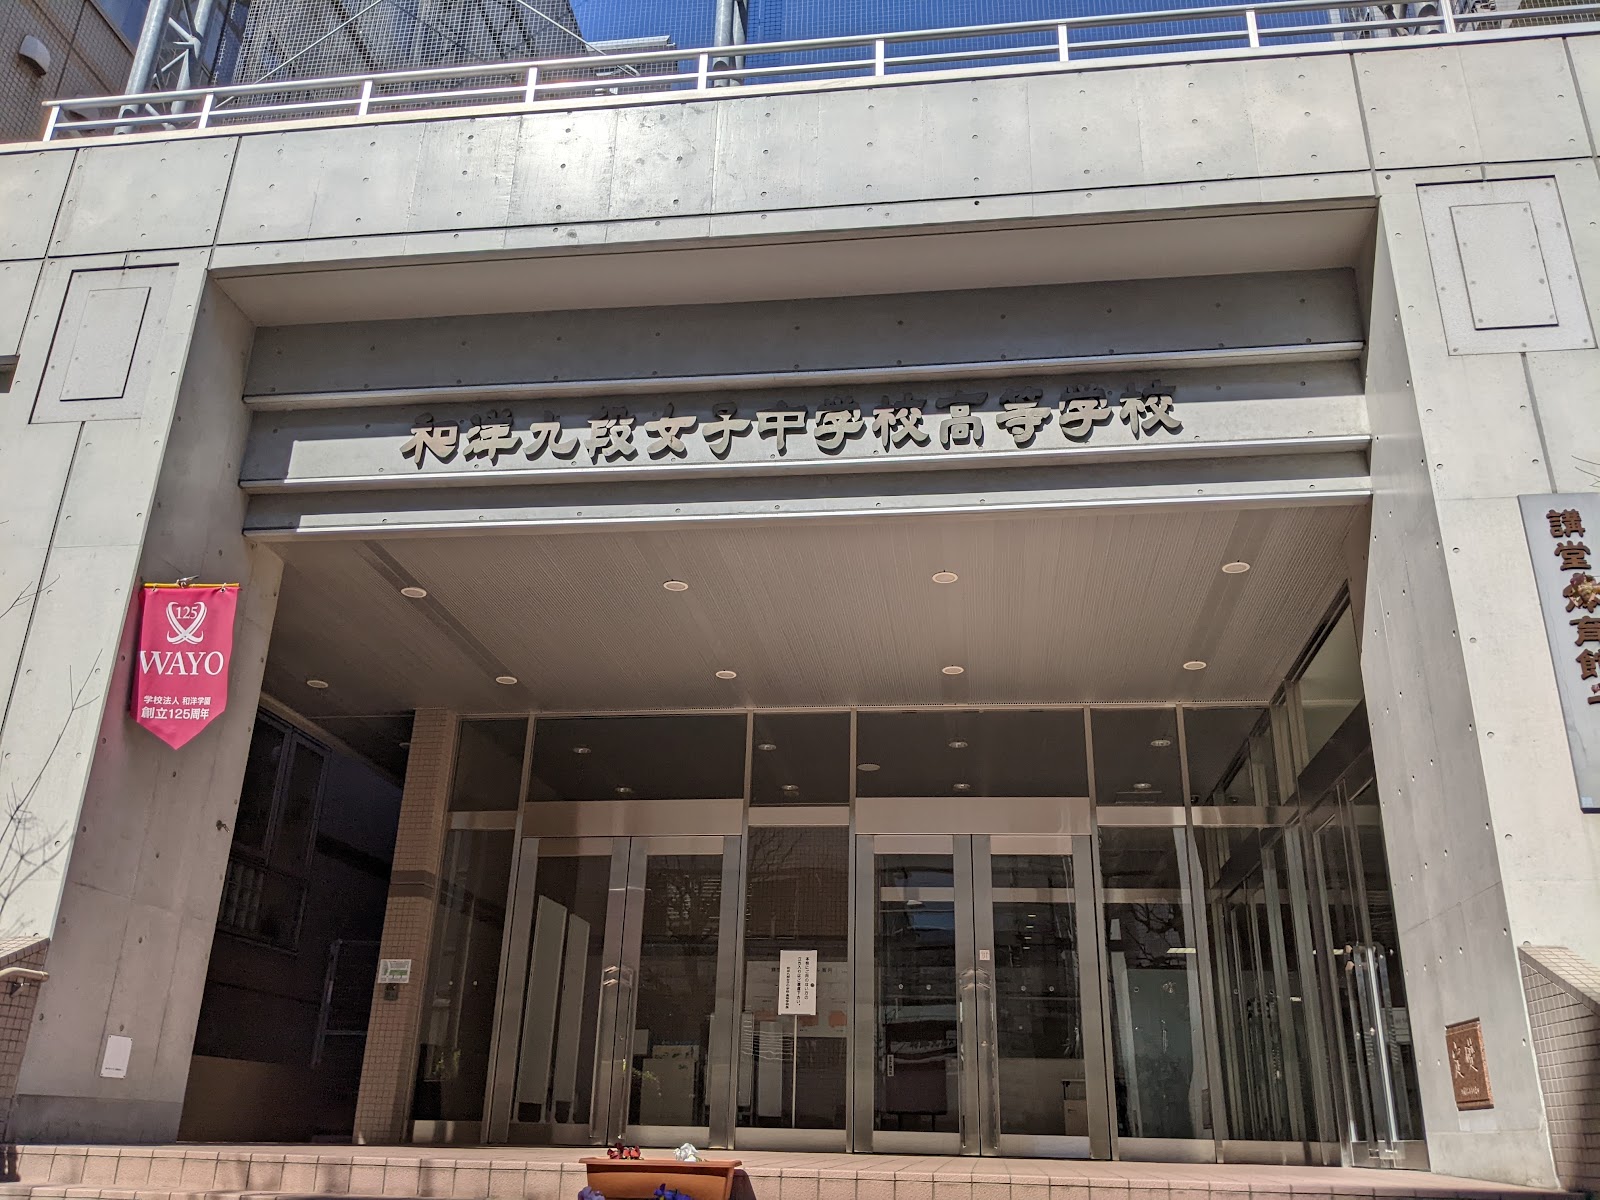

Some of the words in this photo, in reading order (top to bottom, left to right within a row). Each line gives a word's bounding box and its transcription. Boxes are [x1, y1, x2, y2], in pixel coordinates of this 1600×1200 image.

[399, 379, 1184, 468] 和洋九段女子中学校高等学校
[176, 606, 198, 620] 125
[140, 650, 224, 676] WAYO
[143, 695, 180, 706] 学校法人
[182, 696, 212, 706] 和洋学園
[141, 706, 210, 720] 創立125周年
